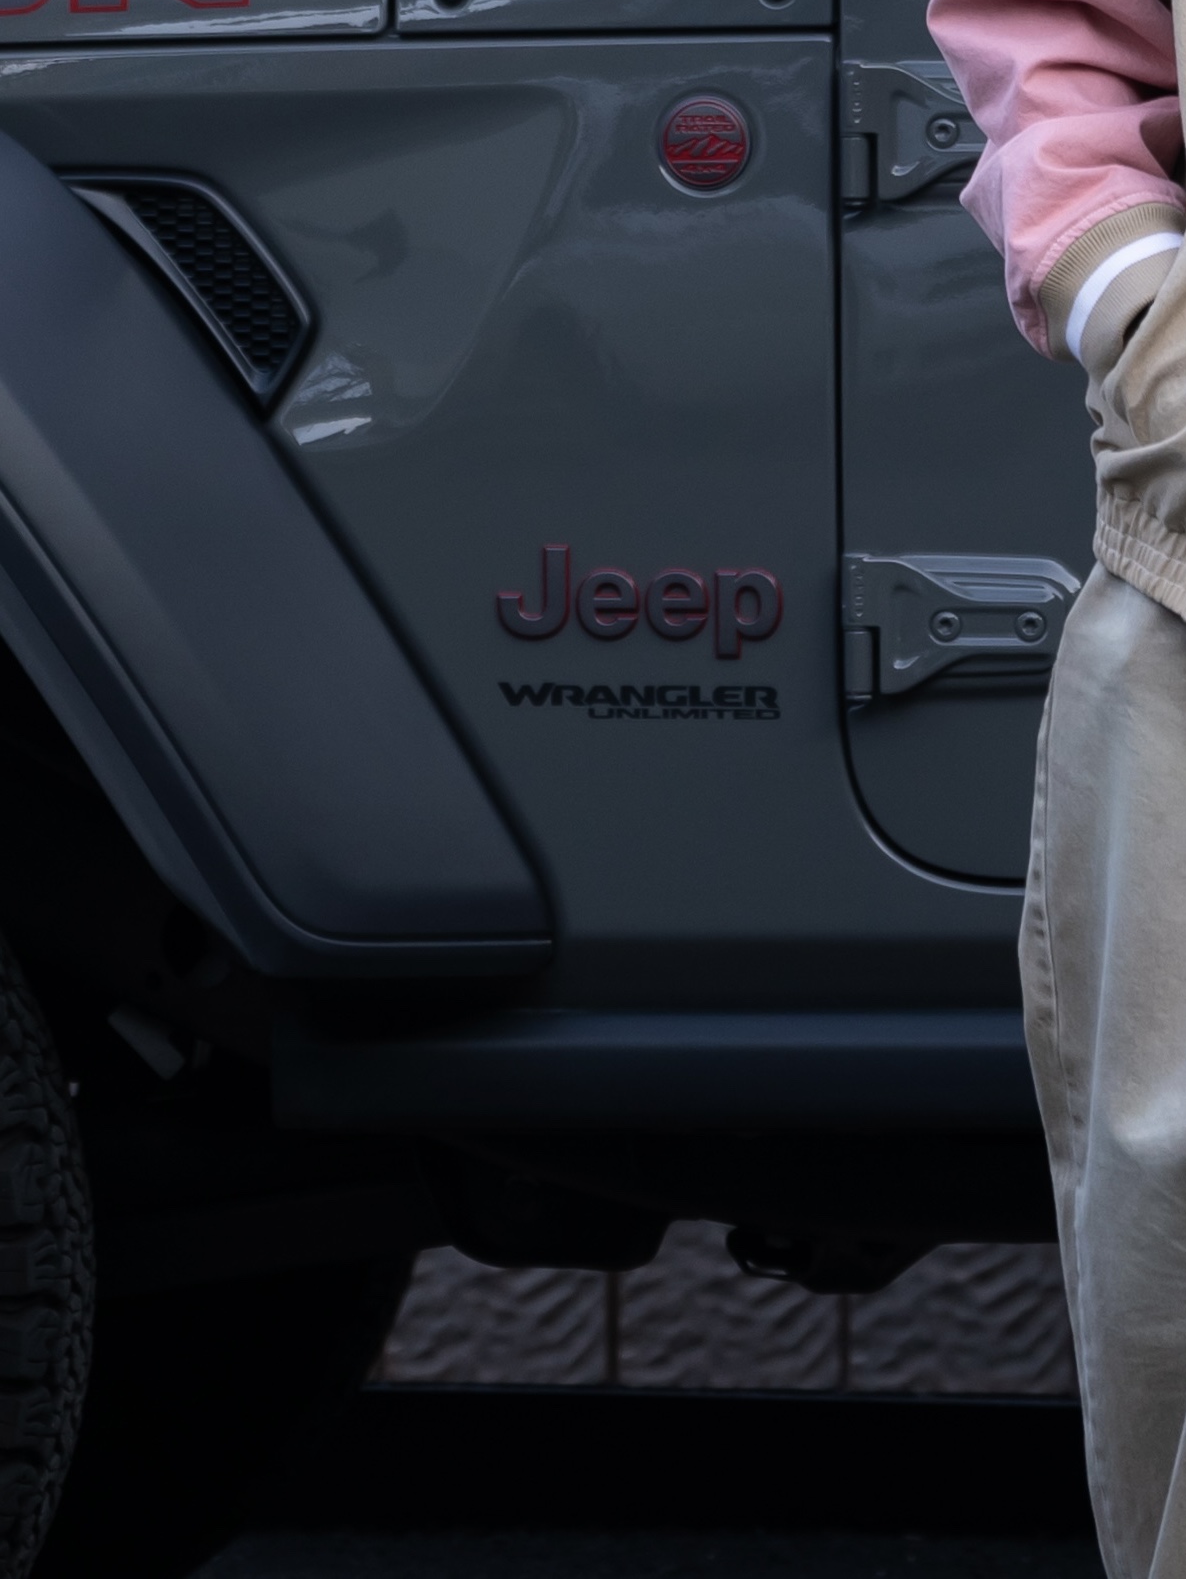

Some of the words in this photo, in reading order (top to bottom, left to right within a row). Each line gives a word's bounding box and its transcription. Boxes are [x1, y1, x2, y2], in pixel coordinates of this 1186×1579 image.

[496, 544, 784, 660] Jeep
[498, 682, 779, 708] WRANGLER
[588, 708, 781, 720] UNLIMITED
